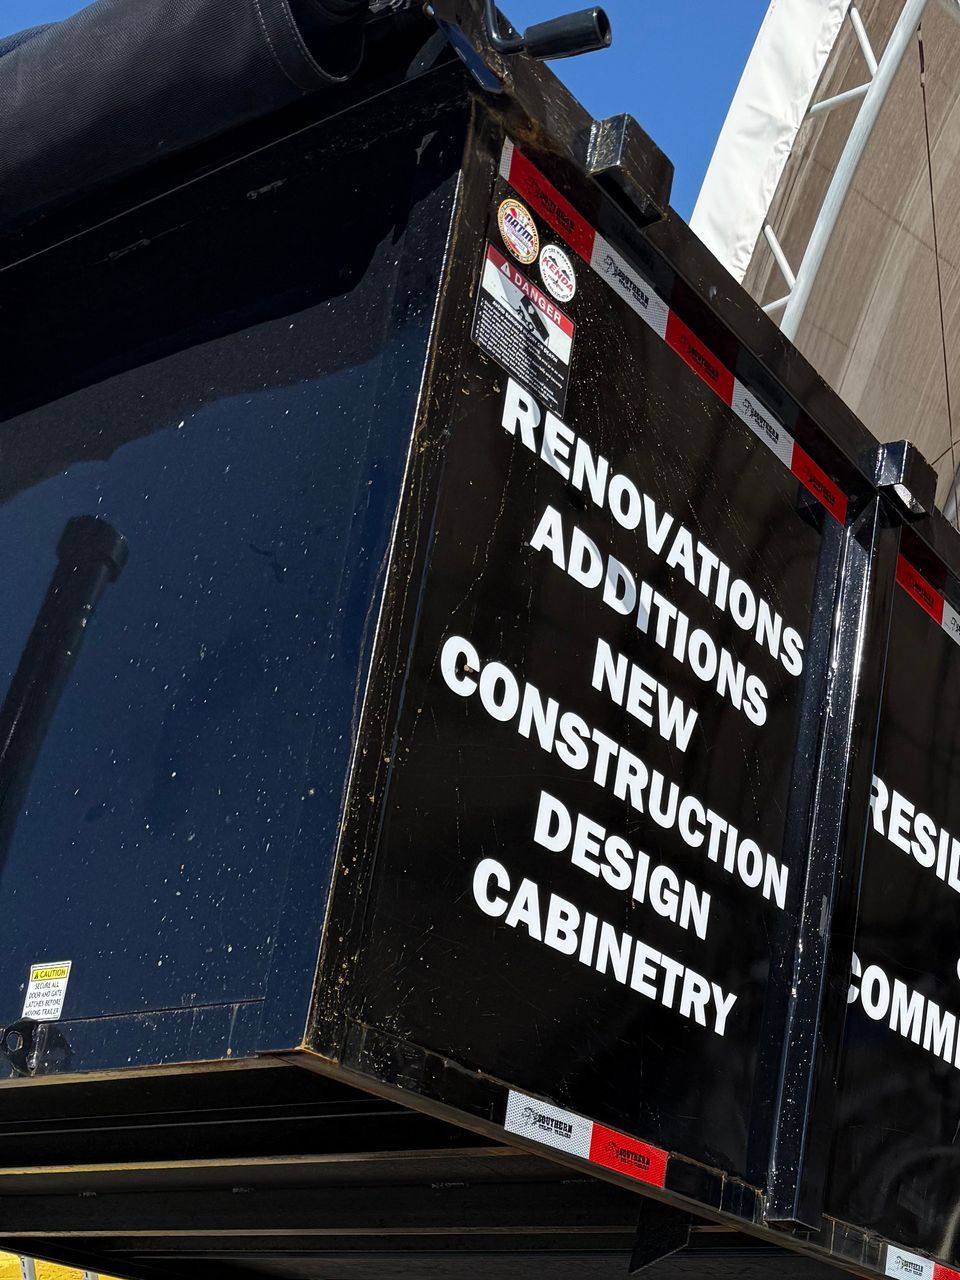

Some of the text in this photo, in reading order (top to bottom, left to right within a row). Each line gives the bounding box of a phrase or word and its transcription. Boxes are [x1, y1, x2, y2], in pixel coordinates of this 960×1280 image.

[514, 272, 562, 324] DANGER
[543, 257, 573, 292] KENDA
[501, 377, 804, 676] RENOVATIONS
[530, 505, 768, 726] ADDITIONS
[591, 638, 698, 752] NEW
[440, 635, 789, 910] CONSTRUCTION
[533, 790, 711, 940] DESIGN
[40, 969, 66, 978] CAUTION
[473, 858, 738, 1036] CABINETRY
[538, 1113, 573, 1134] SOUTHERN
